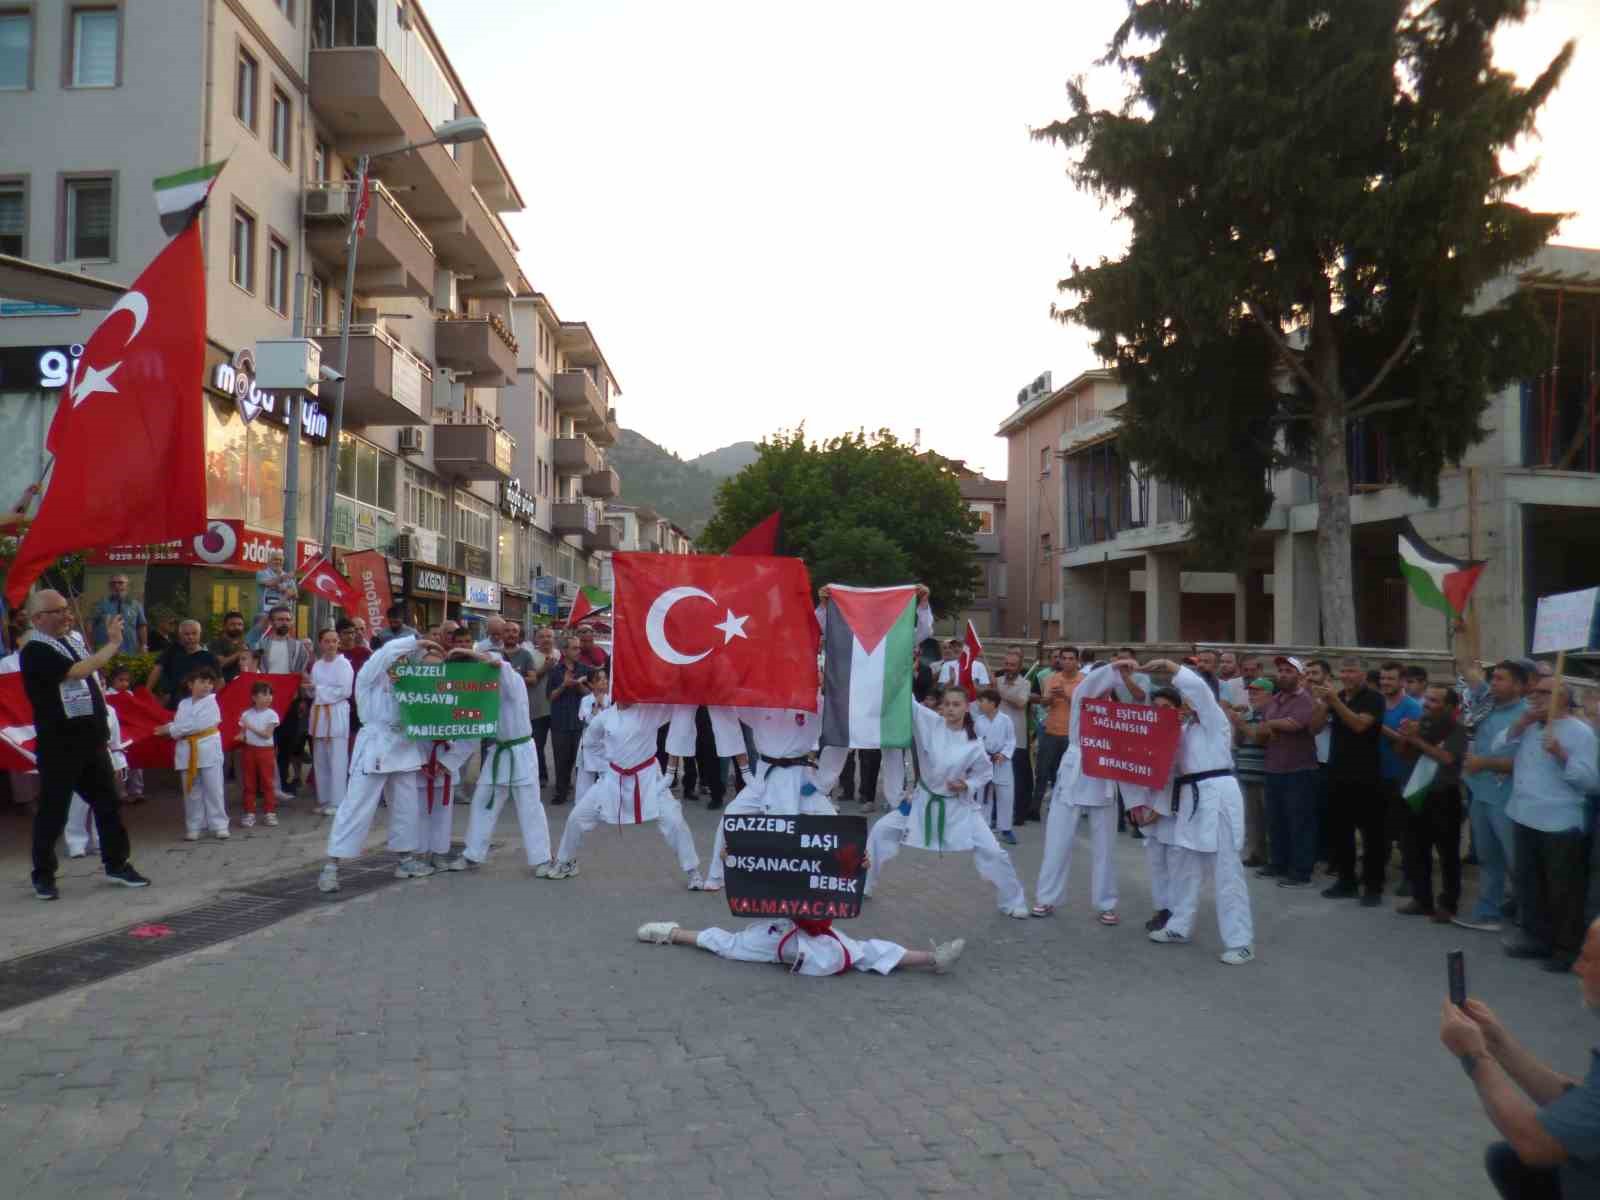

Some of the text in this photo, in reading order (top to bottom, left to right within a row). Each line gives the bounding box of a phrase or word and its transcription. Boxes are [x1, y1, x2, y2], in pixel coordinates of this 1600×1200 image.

[724, 817, 795, 834] GAZZEDE
[800, 834, 838, 851] BAŞI
[725, 855, 822, 873] OKŞANACAK
[809, 875, 858, 893] BEBEK
[729, 896, 858, 917] KALMAYACAK!
